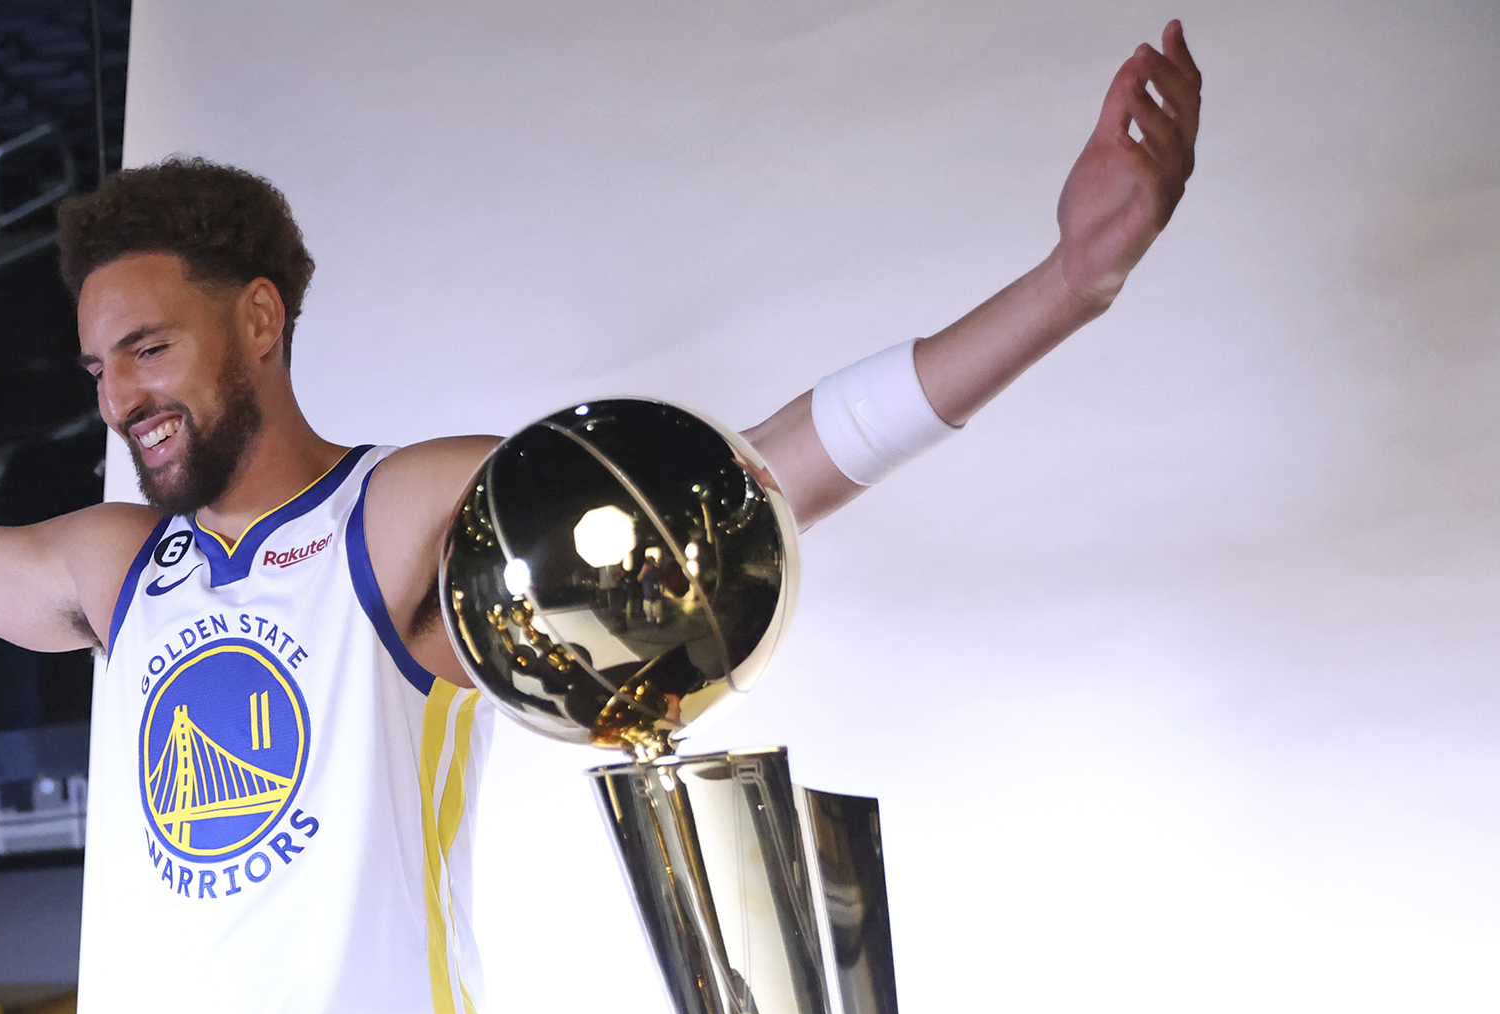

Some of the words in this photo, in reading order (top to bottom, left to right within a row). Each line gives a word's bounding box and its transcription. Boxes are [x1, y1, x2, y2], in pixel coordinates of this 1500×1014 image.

[160, 535, 189, 564] 6
[262, 532, 333, 567] Rakuten
[141, 613, 229, 695] GOLDEN
[239, 613, 309, 670] STATE
[249, 690, 272, 751] 11
[143, 808, 320, 899] WARRIORS
